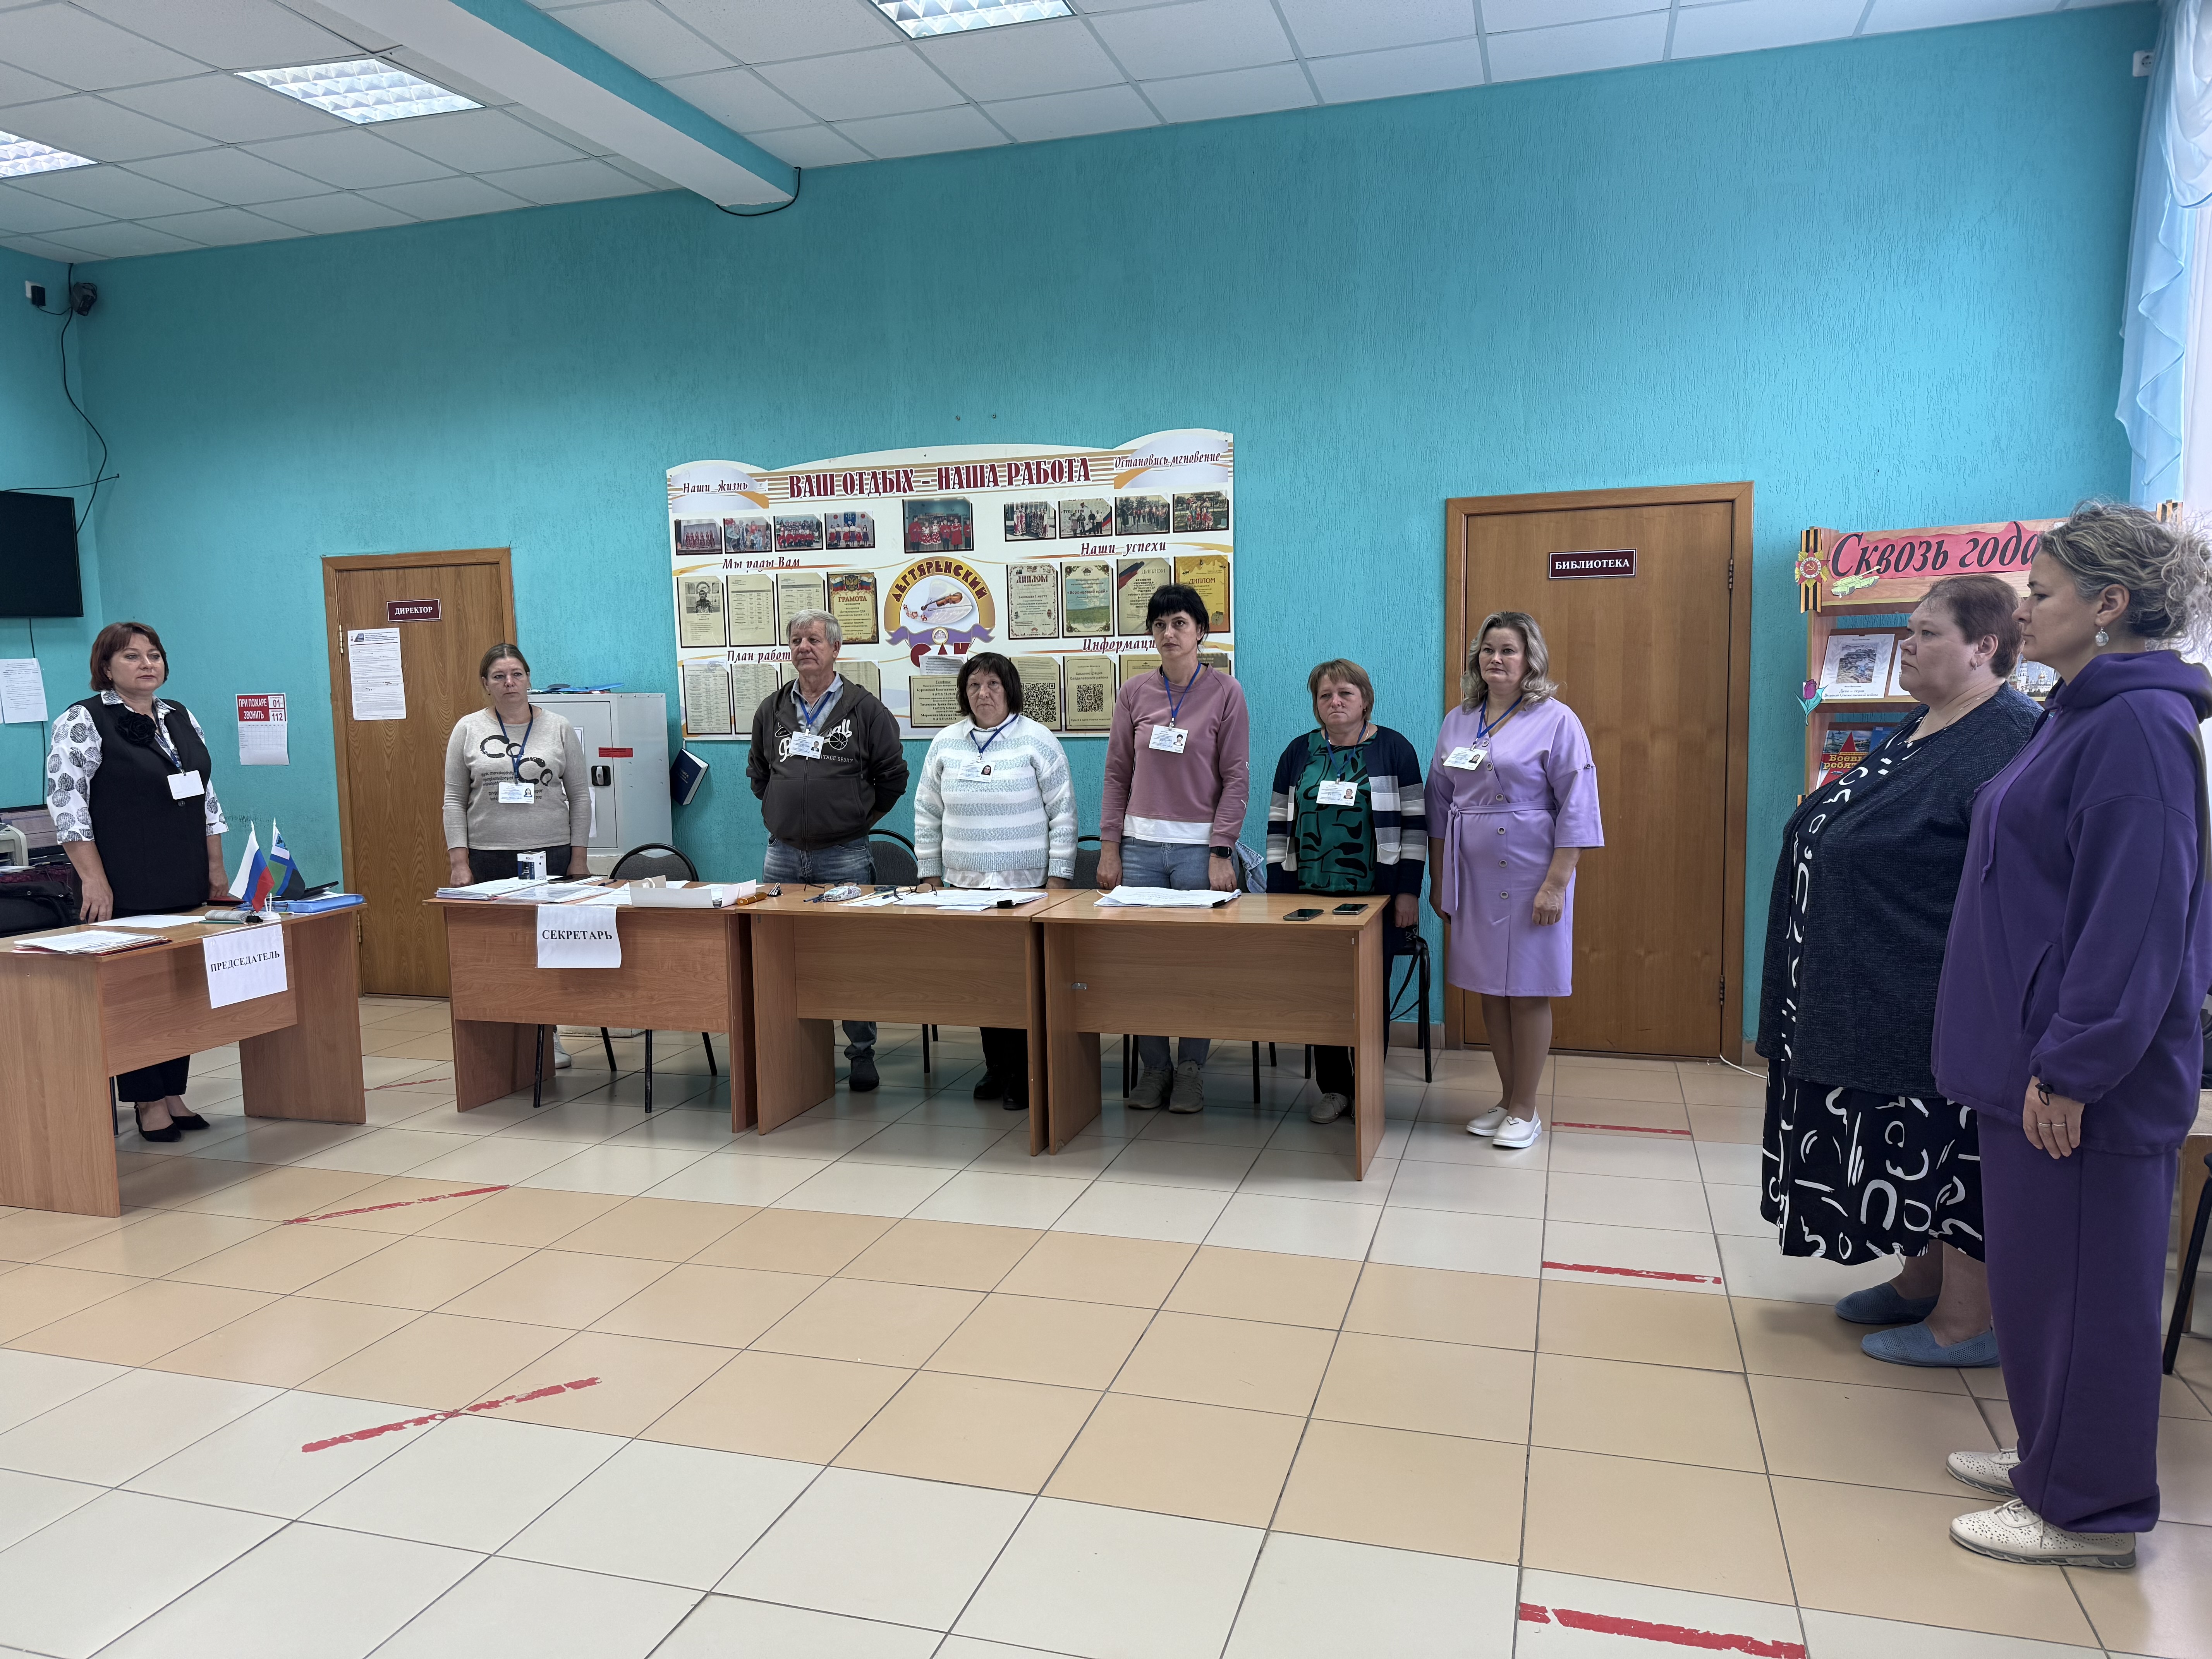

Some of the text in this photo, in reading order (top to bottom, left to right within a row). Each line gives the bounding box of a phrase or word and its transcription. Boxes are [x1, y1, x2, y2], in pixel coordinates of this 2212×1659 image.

[1170, 451, 1220, 466] мгновение
[788, 473, 835, 498] ВАШ
[842, 469, 915, 497] ОТДЫХ
[938, 464, 1000, 490] НАША
[1007, 457, 1091, 486] РАБОТА
[683, 480, 748, 493] Наши жизнь
[1080, 541, 1166, 556] Наши успехи
[1831, 521, 2040, 576] Сквозь года
[722, 556, 800, 572] Мы рады Вам
[1555, 559, 1630, 570] БИБЛИОТЕКА
[1017, 575, 1048, 583] ДИПЛОМ
[395, 606, 433, 615] ДИРЕКТОР
[1083, 637, 1156, 653] Информаци
[727, 649, 791, 663] План работ
[239, 698, 267, 707] ПРИ ПОЖАРЕ
[244, 711, 264, 719] ЗВОНИТЬ
[272, 713, 283, 721] 112
[1822, 761, 1857, 770] ребят
[542, 930, 612, 939] СЕКРЕТАРЬ
[211, 951, 280, 972] ПРЕДСЕДАТЕЛЬ
